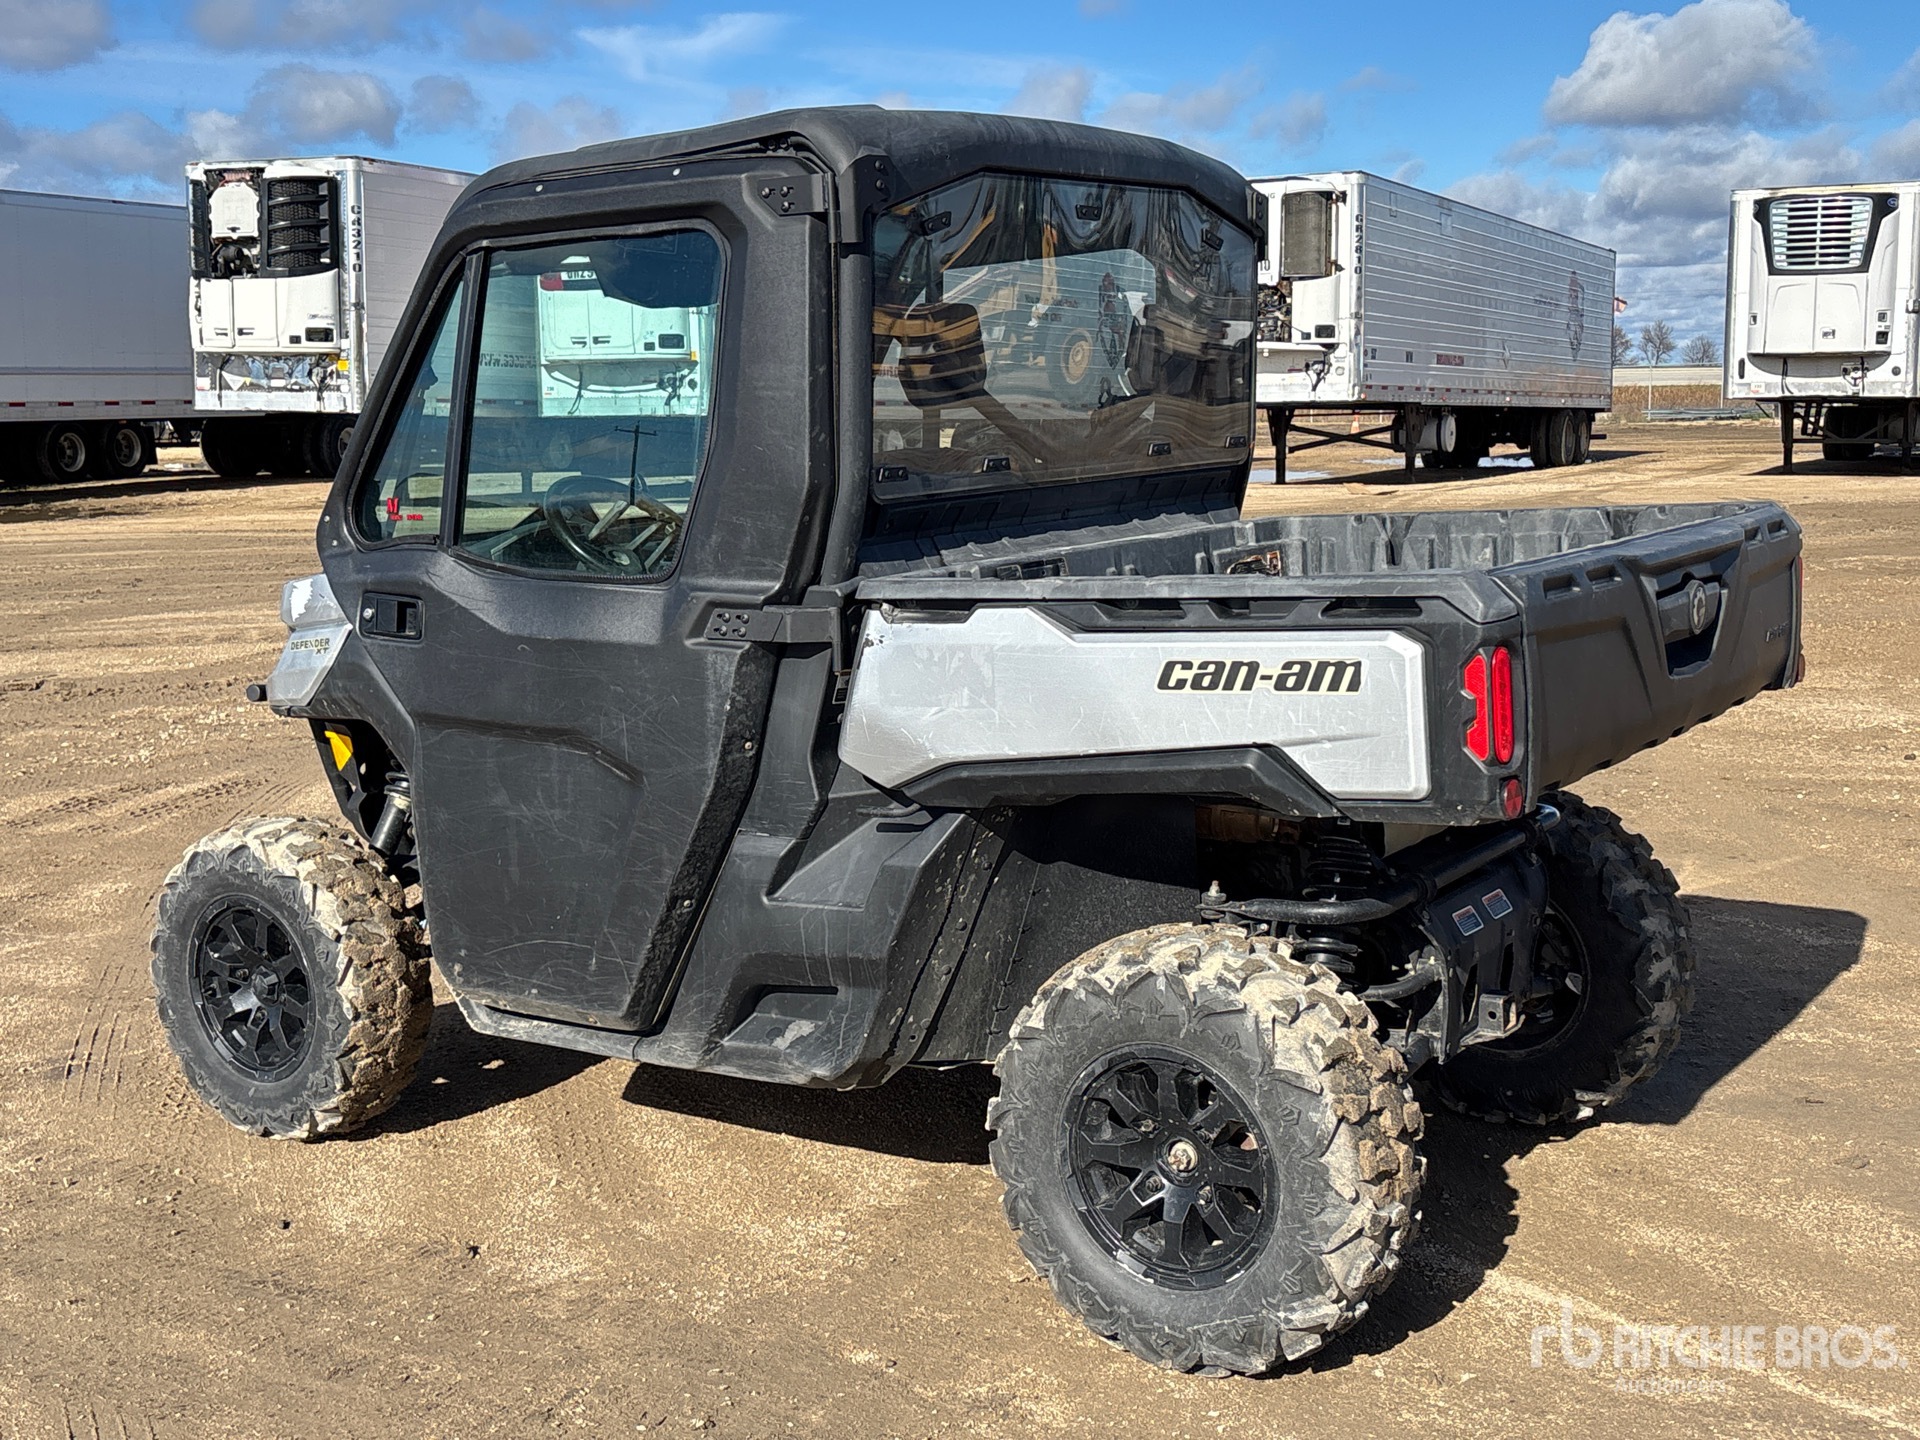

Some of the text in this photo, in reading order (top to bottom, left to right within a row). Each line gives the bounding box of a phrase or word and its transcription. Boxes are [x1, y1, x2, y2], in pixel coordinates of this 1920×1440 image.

[290, 637, 330, 651] DEFENDER
[315, 647, 330, 655] XT
[1156, 660, 1362, 692] can-am
